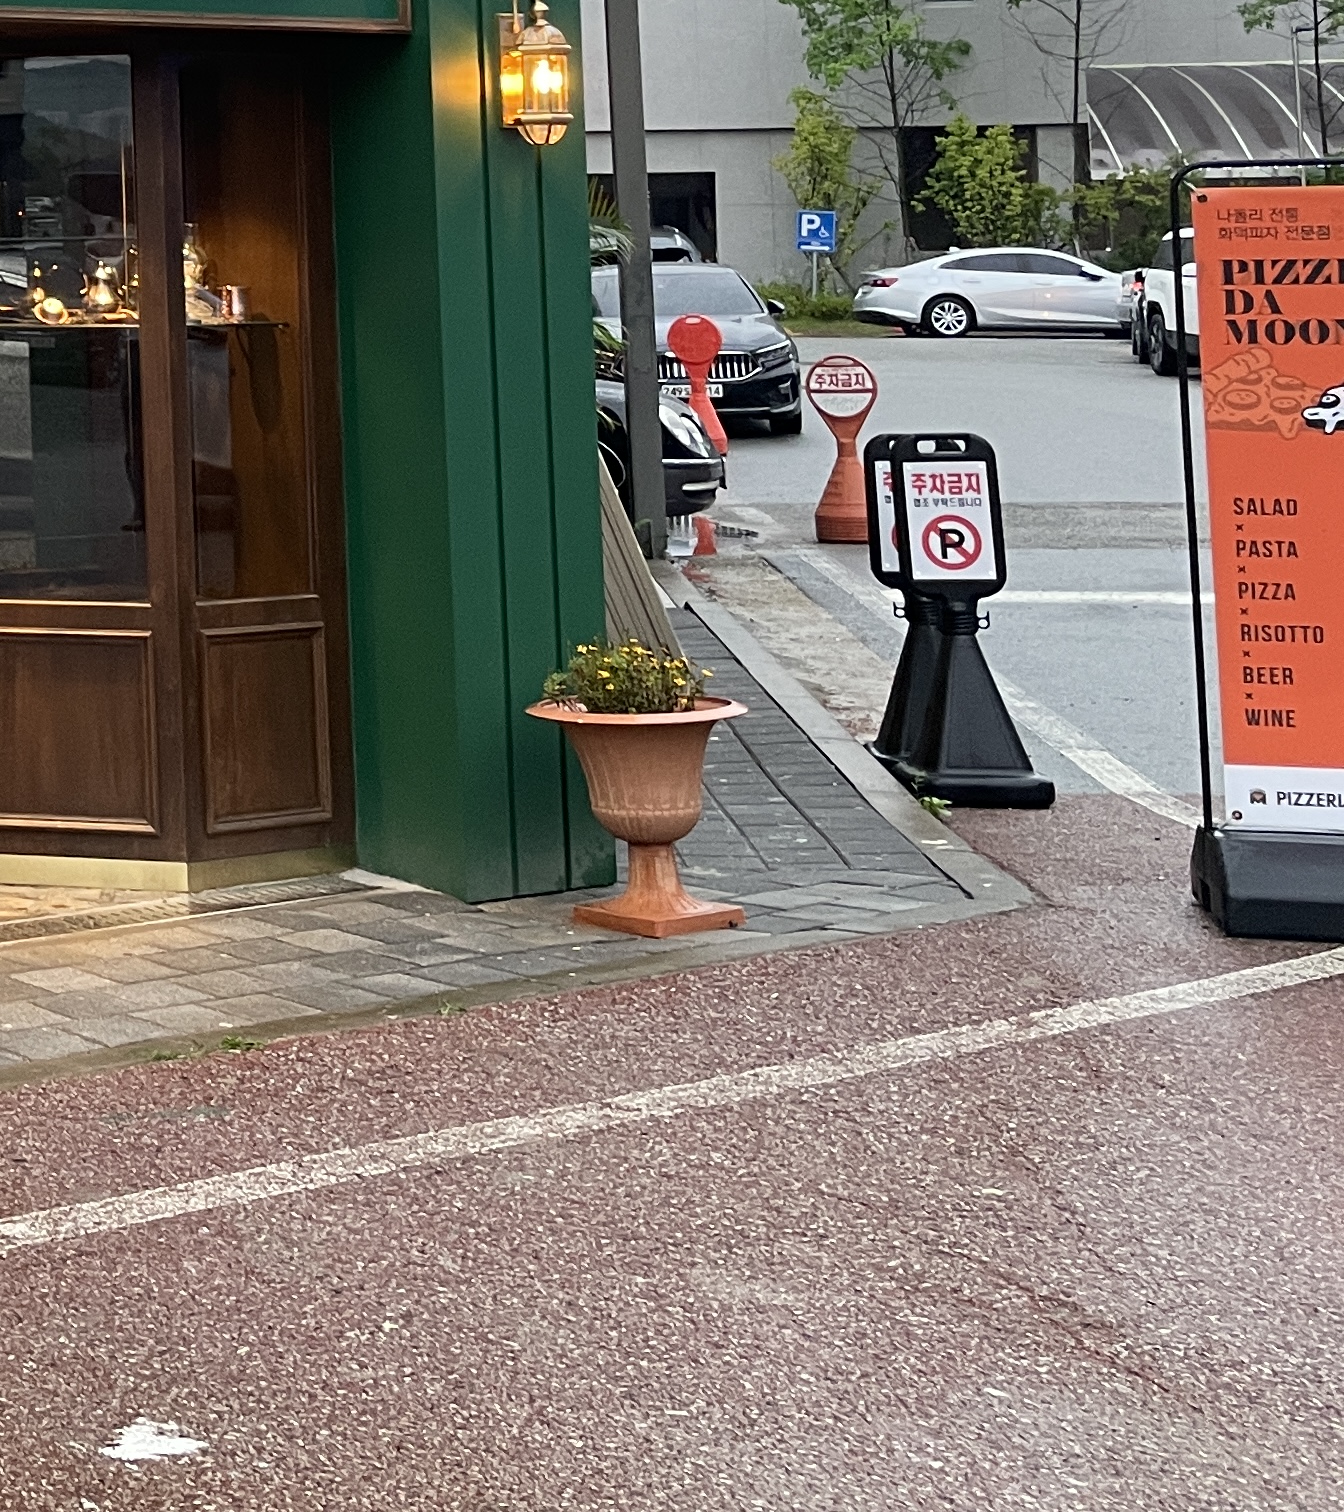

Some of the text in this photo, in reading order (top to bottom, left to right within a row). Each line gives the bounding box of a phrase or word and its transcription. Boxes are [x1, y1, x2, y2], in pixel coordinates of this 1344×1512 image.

[801, 214, 821, 237] P
[1223, 288, 1284, 316] DA
[814, 372, 866, 388] 주차금지
[911, 472, 982, 496] 주차금지
[1233, 497, 1299, 517] SALAD
[1236, 539, 1299, 559] PASTA
[1238, 581, 1297, 601] PIZZA
[1240, 623, 1325, 644] RISOTTO
[1242, 665, 1295, 686] BEER
[1245, 707, 1297, 728] WINE
